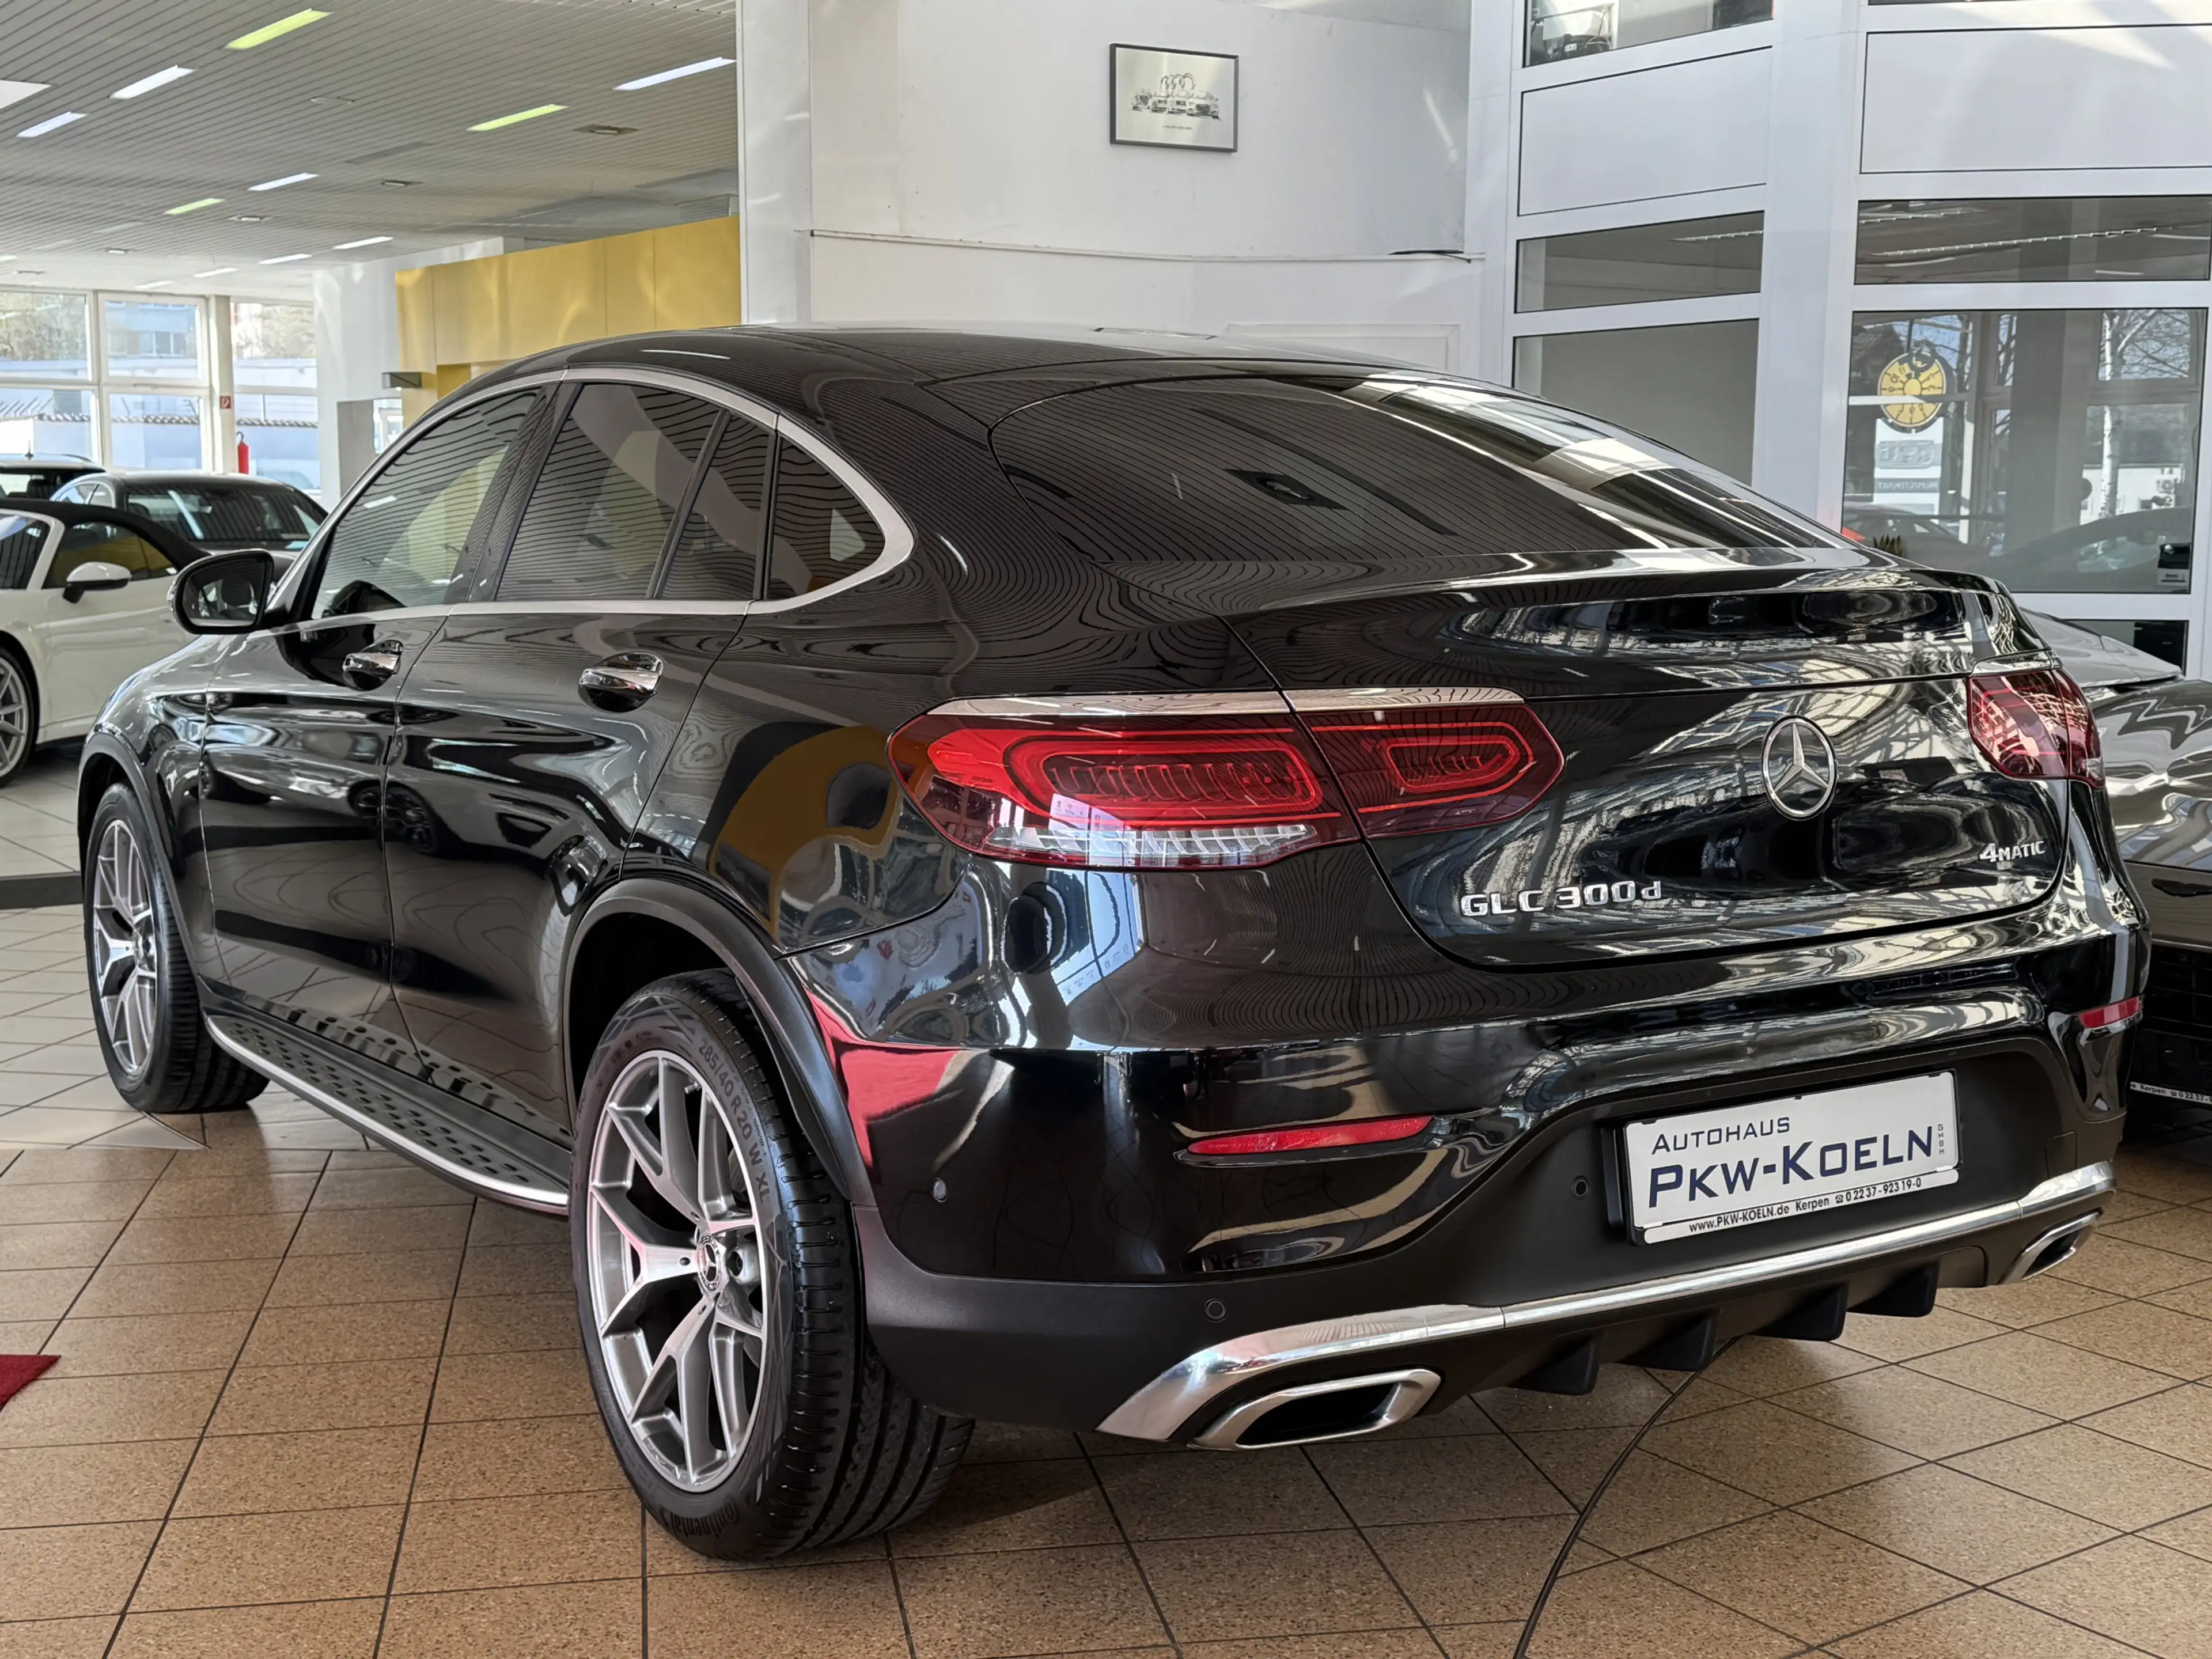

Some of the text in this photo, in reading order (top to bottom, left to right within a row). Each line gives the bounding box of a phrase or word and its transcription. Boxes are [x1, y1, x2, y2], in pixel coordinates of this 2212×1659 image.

[1980, 840, 2046, 862] 4MATIC
[1460, 889, 1545, 917] GLC
[1652, 1117, 1790, 1154] AUTOHAUS
[748, 1142, 763, 1166] W
[1649, 1126, 1933, 1208] PKW-KOELN
[755, 1172, 770, 1205] XL
[1689, 1205, 1790, 1233] www.PKW-KOELN.de
[1796, 1198, 1830, 1212] Kerpen
[670, 1500, 740, 1538] Continental
